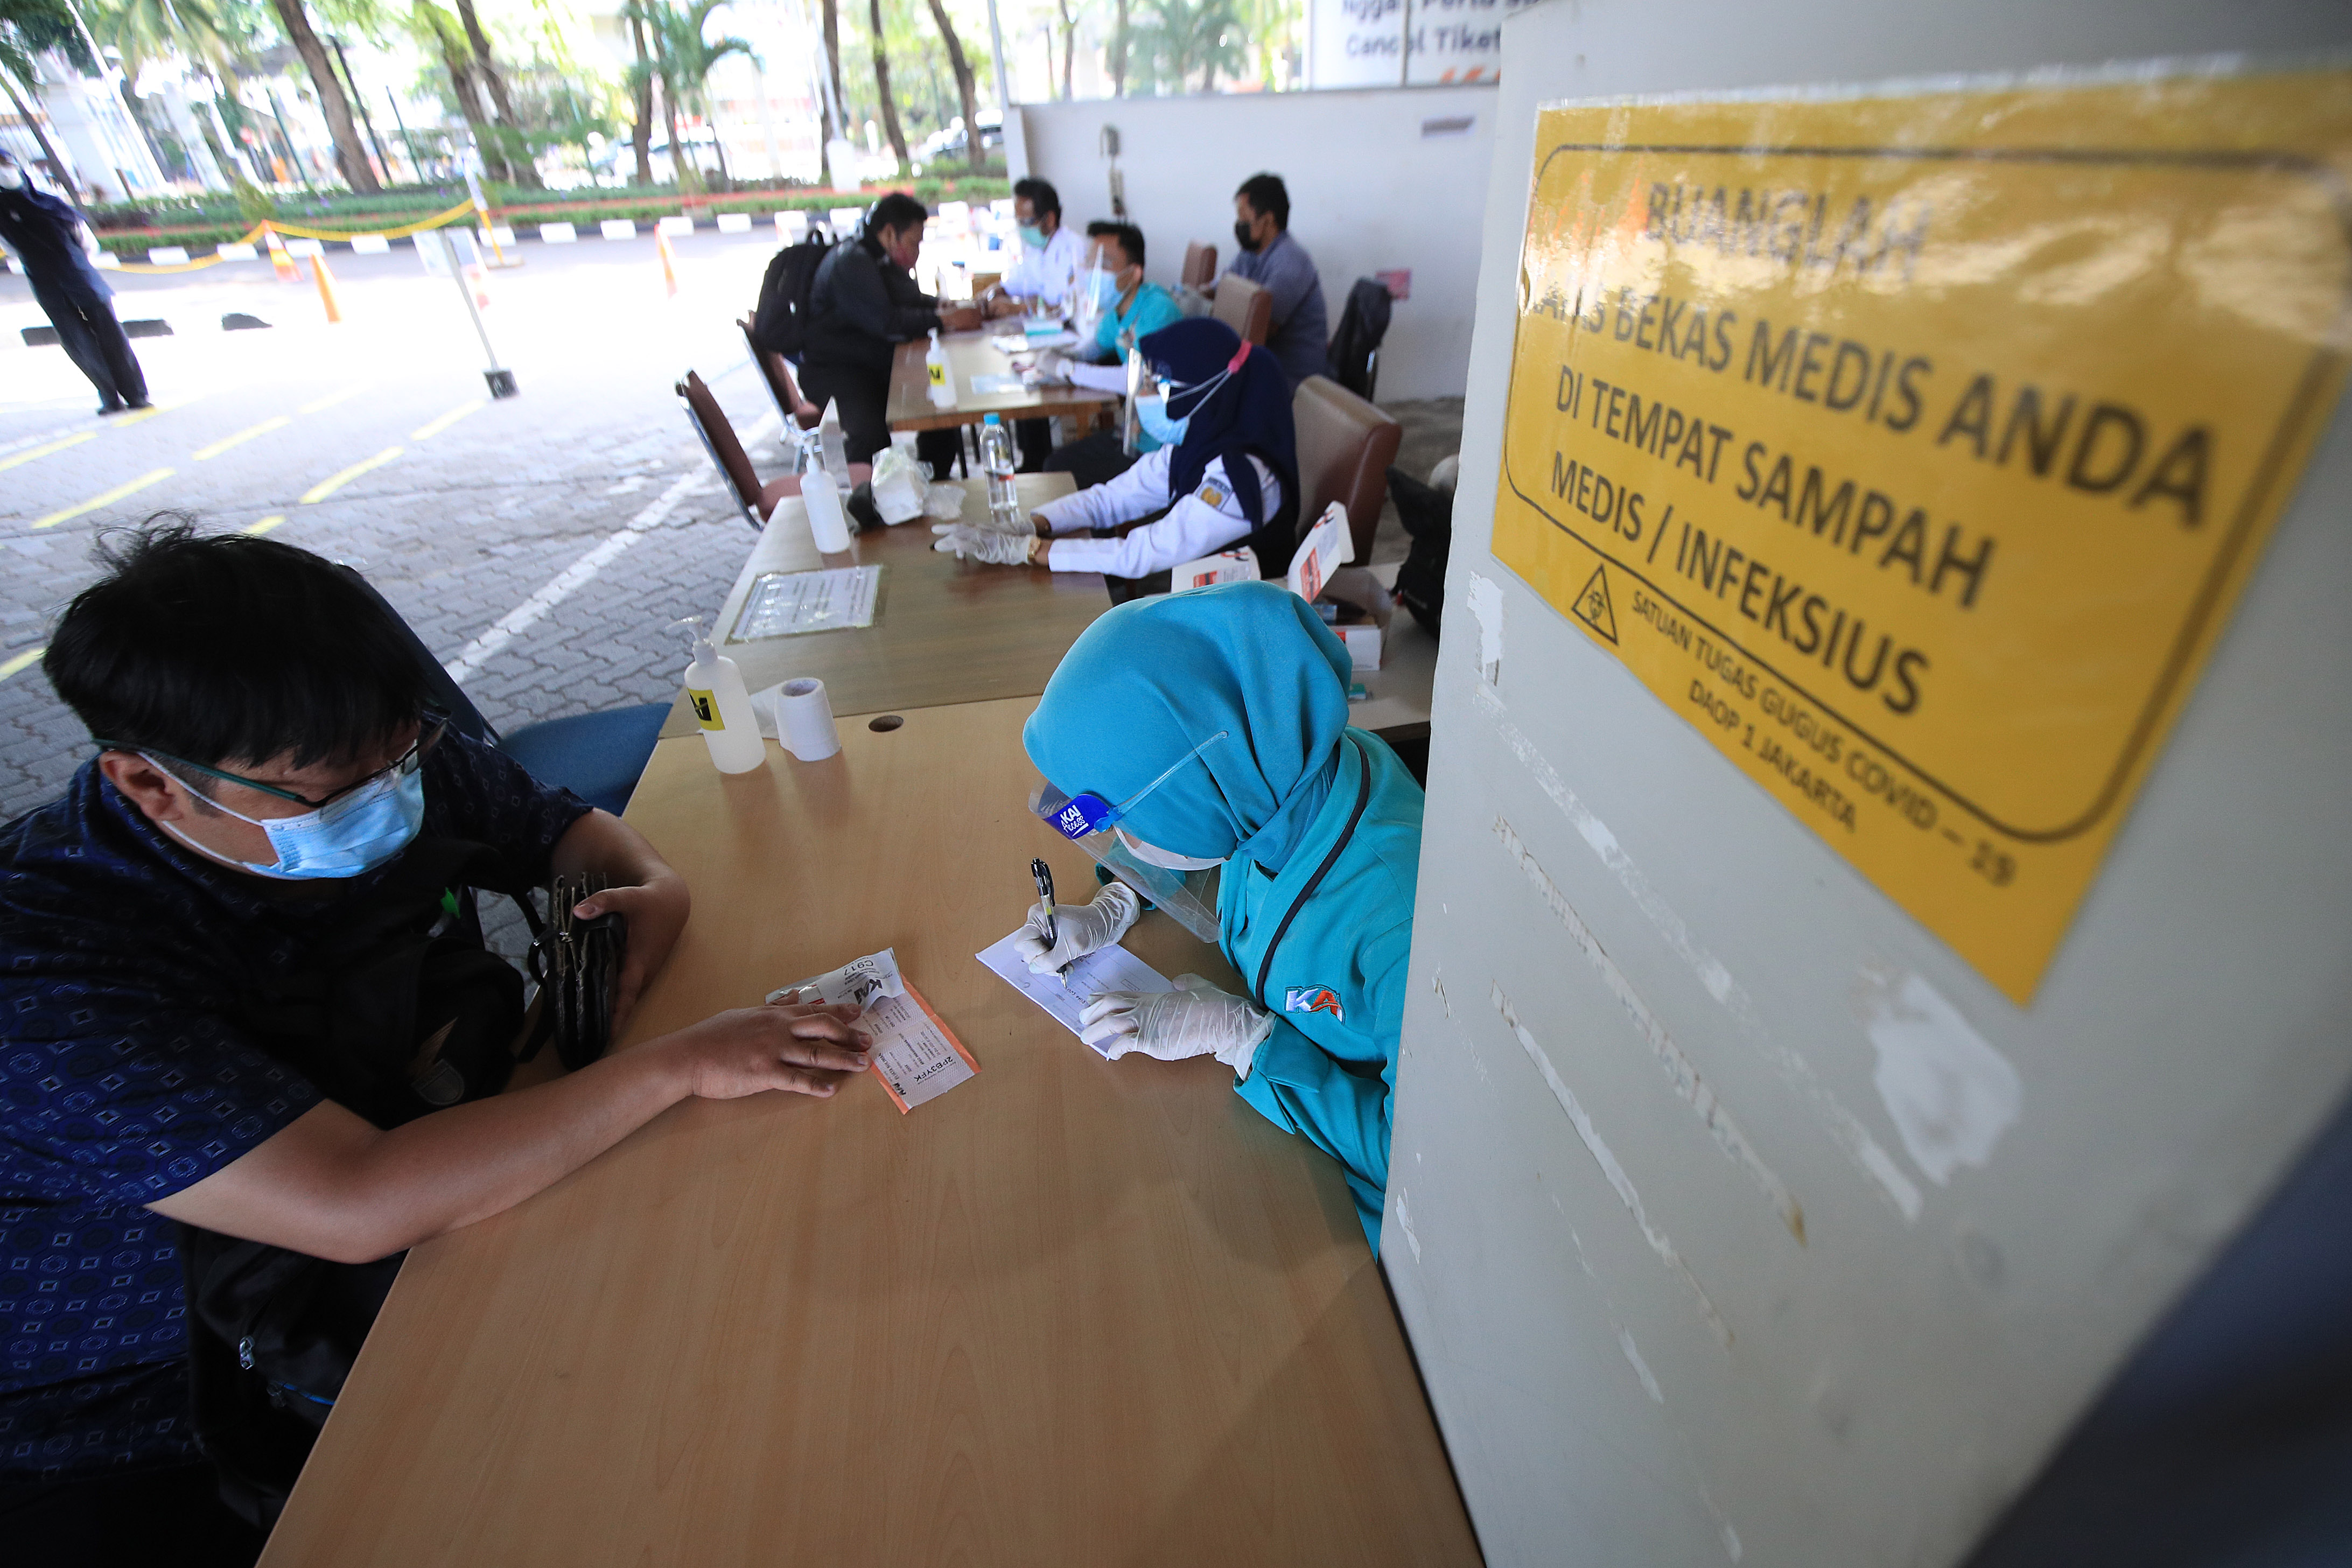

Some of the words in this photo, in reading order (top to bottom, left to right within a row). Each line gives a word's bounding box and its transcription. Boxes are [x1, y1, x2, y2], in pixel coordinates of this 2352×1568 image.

[1614, 286, 1735, 373] BEKAS
[1743, 319, 1935, 433] MEDIS
[1933, 372, 2214, 530] ANDA
[1556, 365, 1583, 419] DI
[1592, 378, 1733, 485] TEMPAT
[1735, 442, 1995, 612] SAMPAH
[1552, 451, 1646, 542] MEDIS
[1646, 505, 1674, 565] /
[1676, 520, 1931, 716] INFEKSIUS
[1632, 591, 1692, 652] SATUAN
[1696, 635, 1759, 701] TUGAS
[1759, 687, 1843, 765] GUGUS
[1845, 750, 1939, 831] COVID
[1969, 840, 2016, 887] 19
[1689, 678, 1741, 733] DAOP
[1740, 725, 1756, 753] 1
[1756, 737, 1855, 834] JAKARTA
[1060, 804, 1081, 824] KAI
[1061, 815, 1086, 833] Access
[844, 960, 873, 976] C917
[854, 979, 883, 1005] KAI
[914, 1056, 953, 1082] 2PB3YFK
